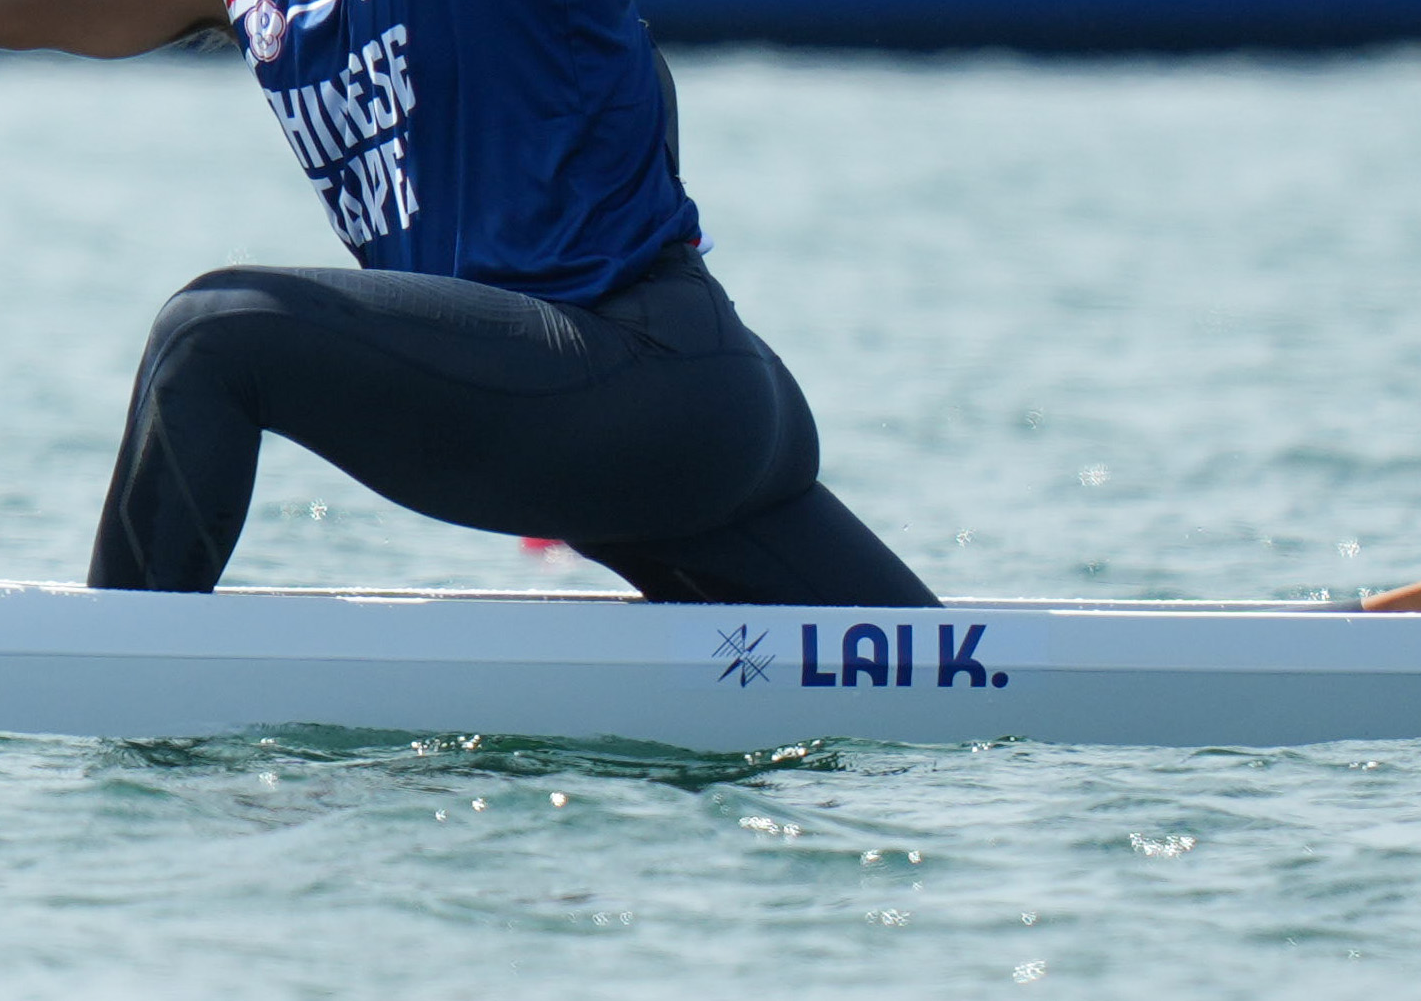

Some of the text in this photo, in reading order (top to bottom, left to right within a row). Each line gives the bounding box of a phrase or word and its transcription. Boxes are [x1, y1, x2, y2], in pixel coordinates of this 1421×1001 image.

[262, 23, 416, 169] HINESE
[802, 623, 1009, 688] LAI K.
